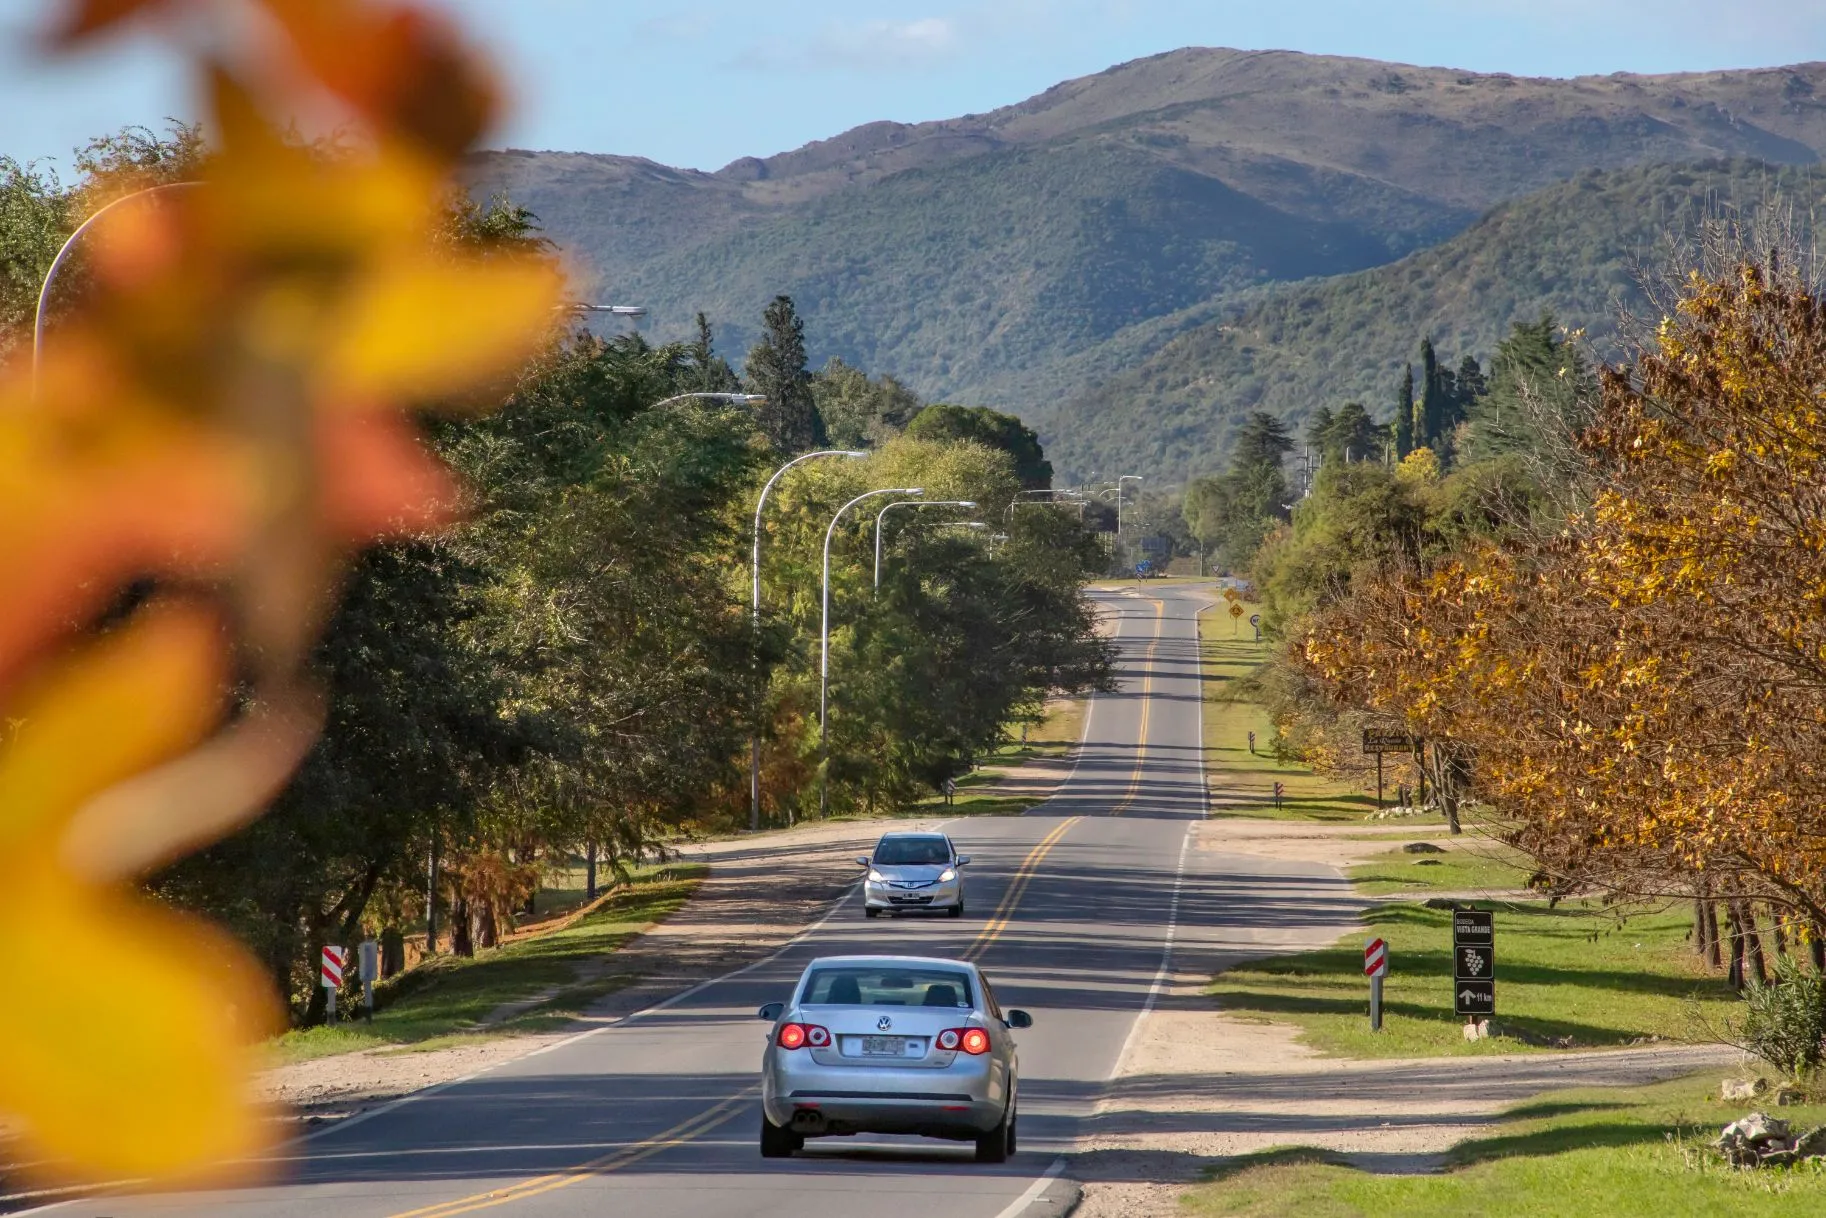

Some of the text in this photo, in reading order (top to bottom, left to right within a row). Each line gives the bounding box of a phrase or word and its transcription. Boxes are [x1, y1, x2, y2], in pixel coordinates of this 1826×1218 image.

[1456, 926, 1491, 934] VISTA GRANDE
[1476, 992, 1492, 1002] 11 km
